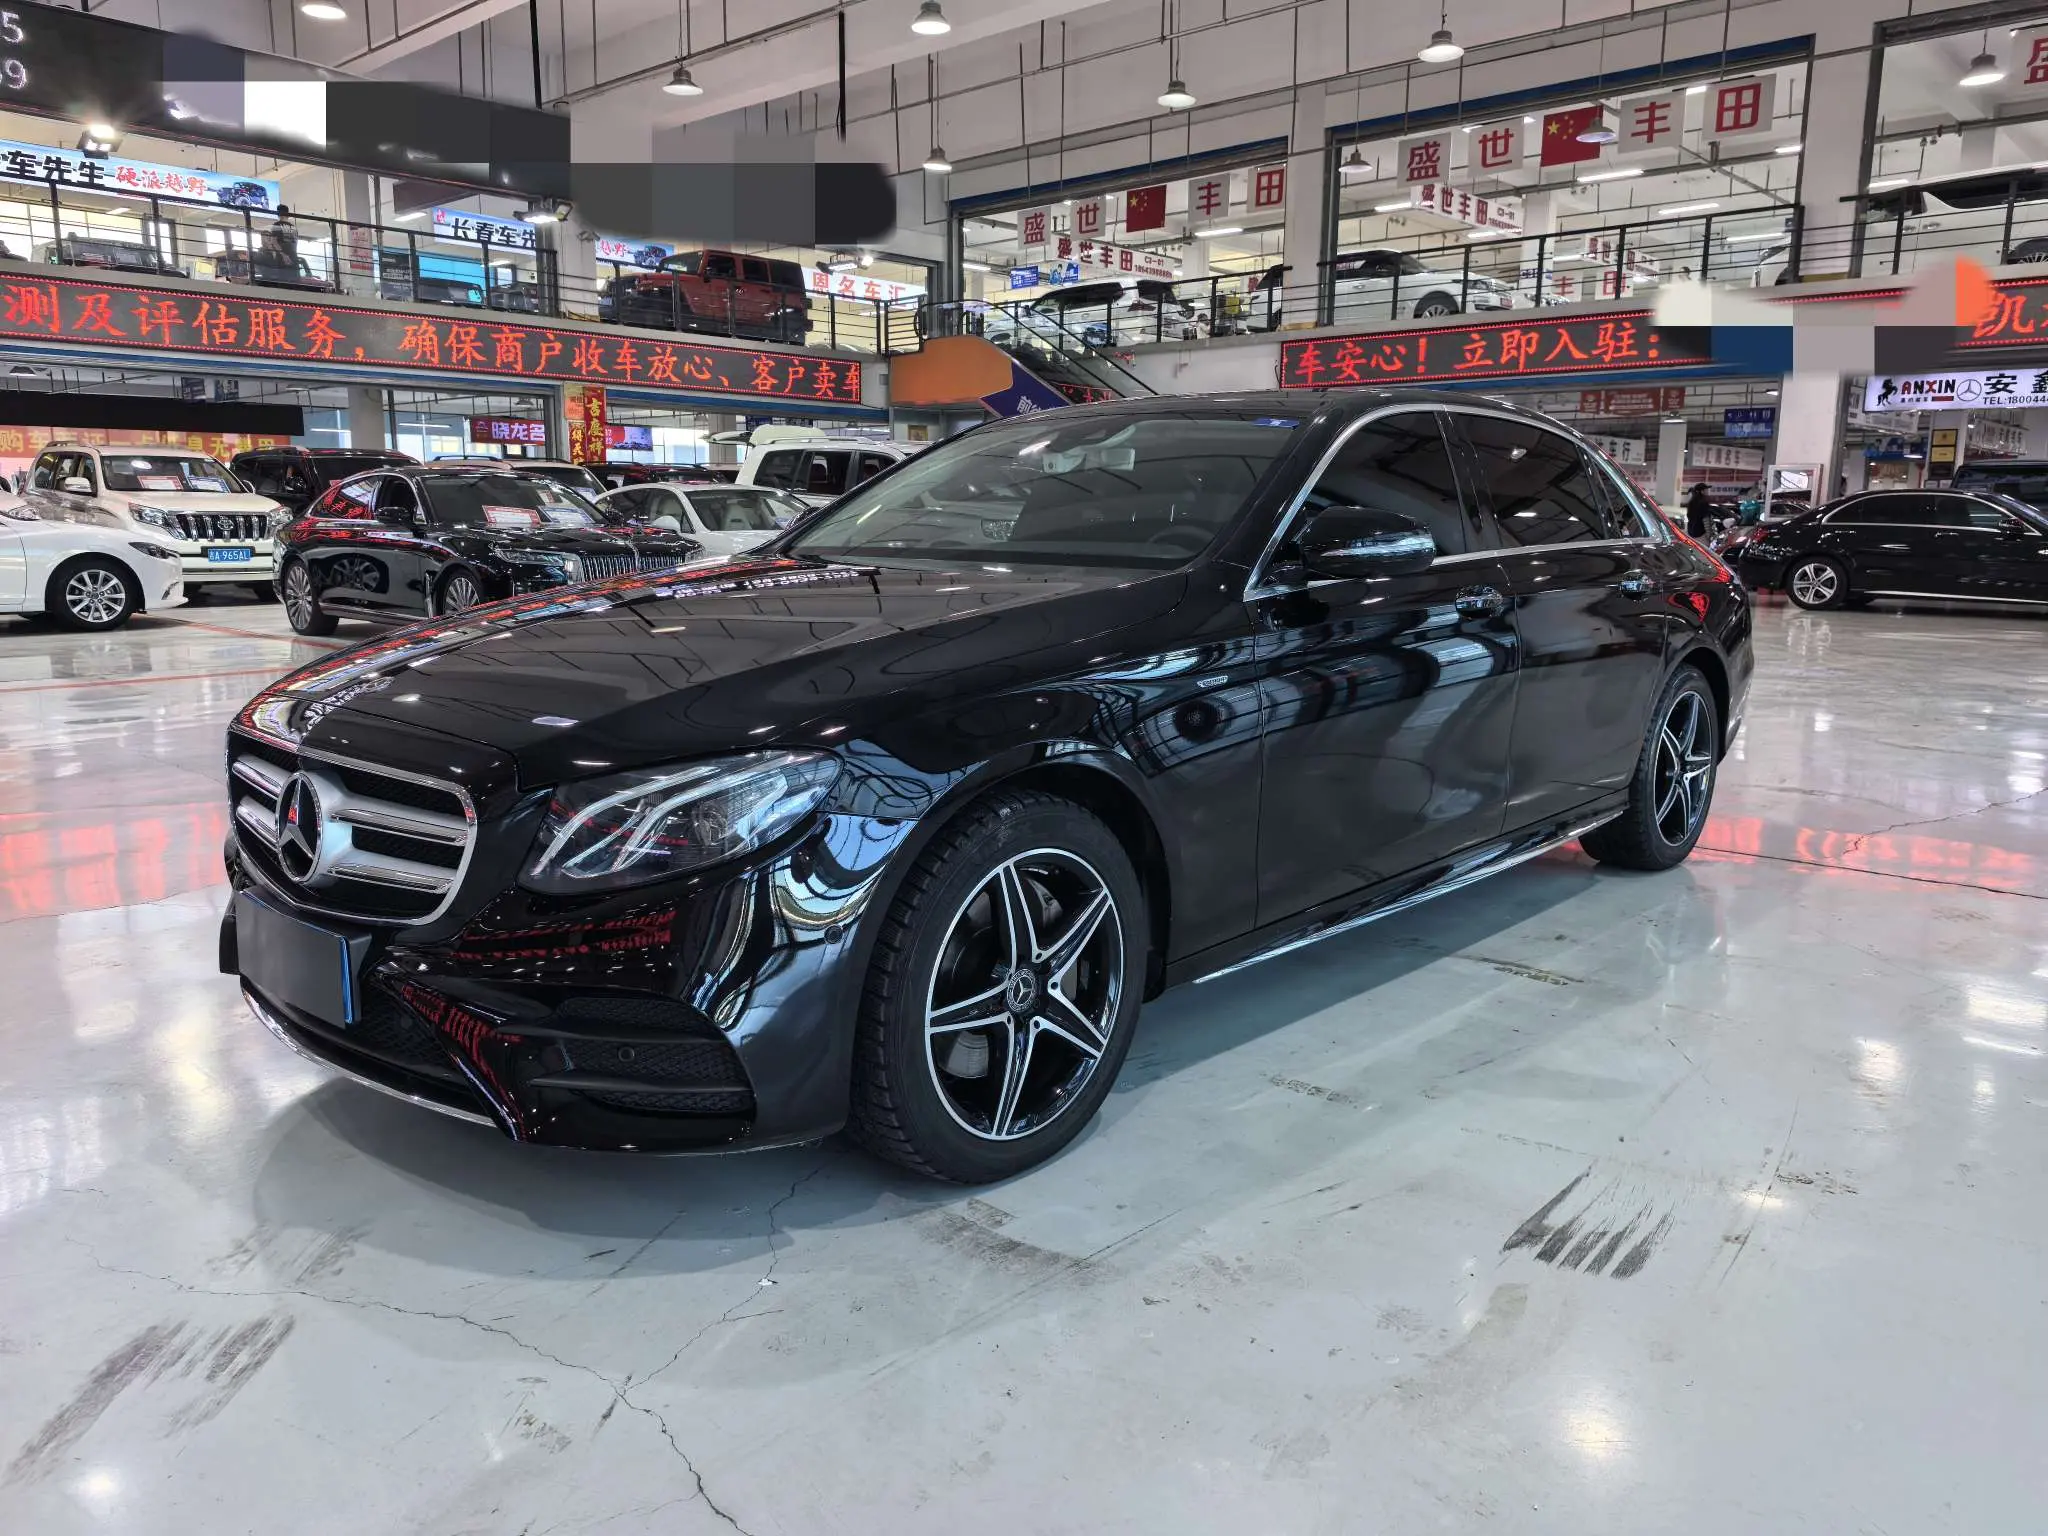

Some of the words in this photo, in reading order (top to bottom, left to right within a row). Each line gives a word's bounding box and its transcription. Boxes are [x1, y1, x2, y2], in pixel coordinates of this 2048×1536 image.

[0, 58, 27, 89] 9
[1406, 141, 1440, 181] 盛
[1478, 128, 1513, 169] 世
[1631, 101, 1671, 143] 丰
[1715, 82, 1763, 133] 田
[8, 149, 105, 186] 车先生
[114, 166, 208, 197] 硬派越野
[1023, 211, 1046, 245] 盛
[1076, 202, 1100, 235] 世
[1196, 181, 1222, 216] 丰
[1255, 168, 1285, 208] 田
[1058, 236, 1133, 272] 盛世丰田
[1901, 378, 1956, 396] ANXIN
[1983, 395, 2048, 405] TEL:180044
